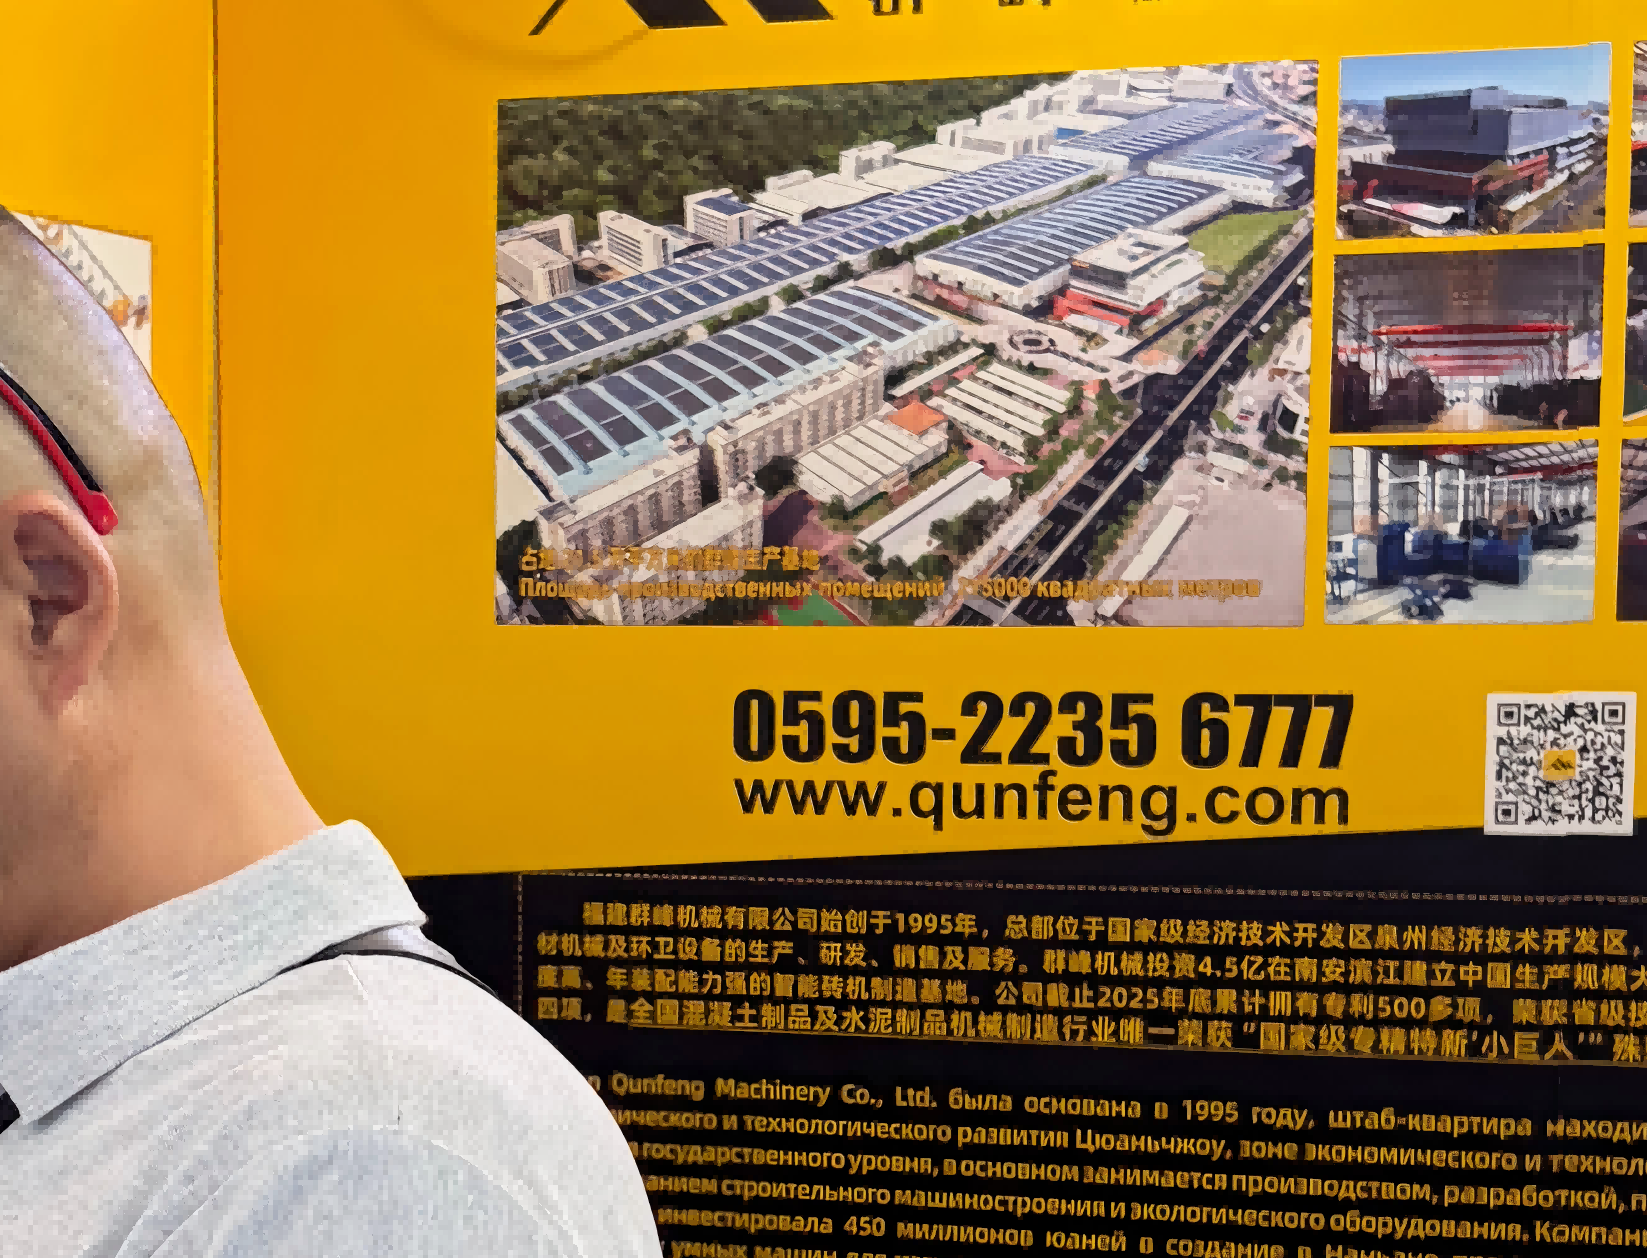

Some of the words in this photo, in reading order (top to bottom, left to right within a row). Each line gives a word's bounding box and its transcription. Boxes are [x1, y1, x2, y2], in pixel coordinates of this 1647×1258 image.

[819, 577, 944, 599] помещений
[732, 690, 1156, 768] 0595-2235
[1181, 692, 1354, 770] 6777
[734, 771, 1351, 837] www.qunfeng.com
[612, 1074, 704, 1100] Qunfeng
[717, 1079, 830, 1106] Machinery
[842, 1084, 882, 1107] Co.,
[896, 1087, 936, 1107] Ltd.
[949, 1088, 1012, 1111] была
[1025, 1097, 1140, 1117] основана
[1183, 1100, 1238, 1122] 1995
[1252, 1107, 1314, 1130] году,
[1329, 1108, 1531, 1139] штаб-квартира
[723, 1115, 737, 1130] и
[743, 1115, 951, 1141] технологического
[958, 1127, 1068, 1147] развития
[1076, 1129, 1231, 1160] Цюаньчжоу,
[1241, 1141, 1297, 1160] зоне
[1306, 1144, 1517, 1170] экономического
[1526, 1155, 1540, 1171] и
[643, 1143, 845, 1168] государственного
[848, 1155, 938, 1176] уровня,
[961, 1160, 1078, 1181] основном
[1084, 1166, 1226, 1190] занимается
[1233, 1175, 1438, 1204] производством,
[1445, 1185, 1624, 1213] разработкой,
[658, 1209, 832, 1233] инвестировала
[844, 1216, 885, 1236] 450
[897, 1222, 1033, 1246] миллионов
[1046, 1231, 1126, 1251] юаней
[722, 1180, 890, 1204] строительного
[895, 1192, 1107, 1217] машиностроения
[1111, 1202, 1125, 1218] и
[1131, 1203, 1324, 1230] экологического
[1330, 1210, 1528, 1241] оборудования.
[1536, 1221, 1647, 1246] Компан
